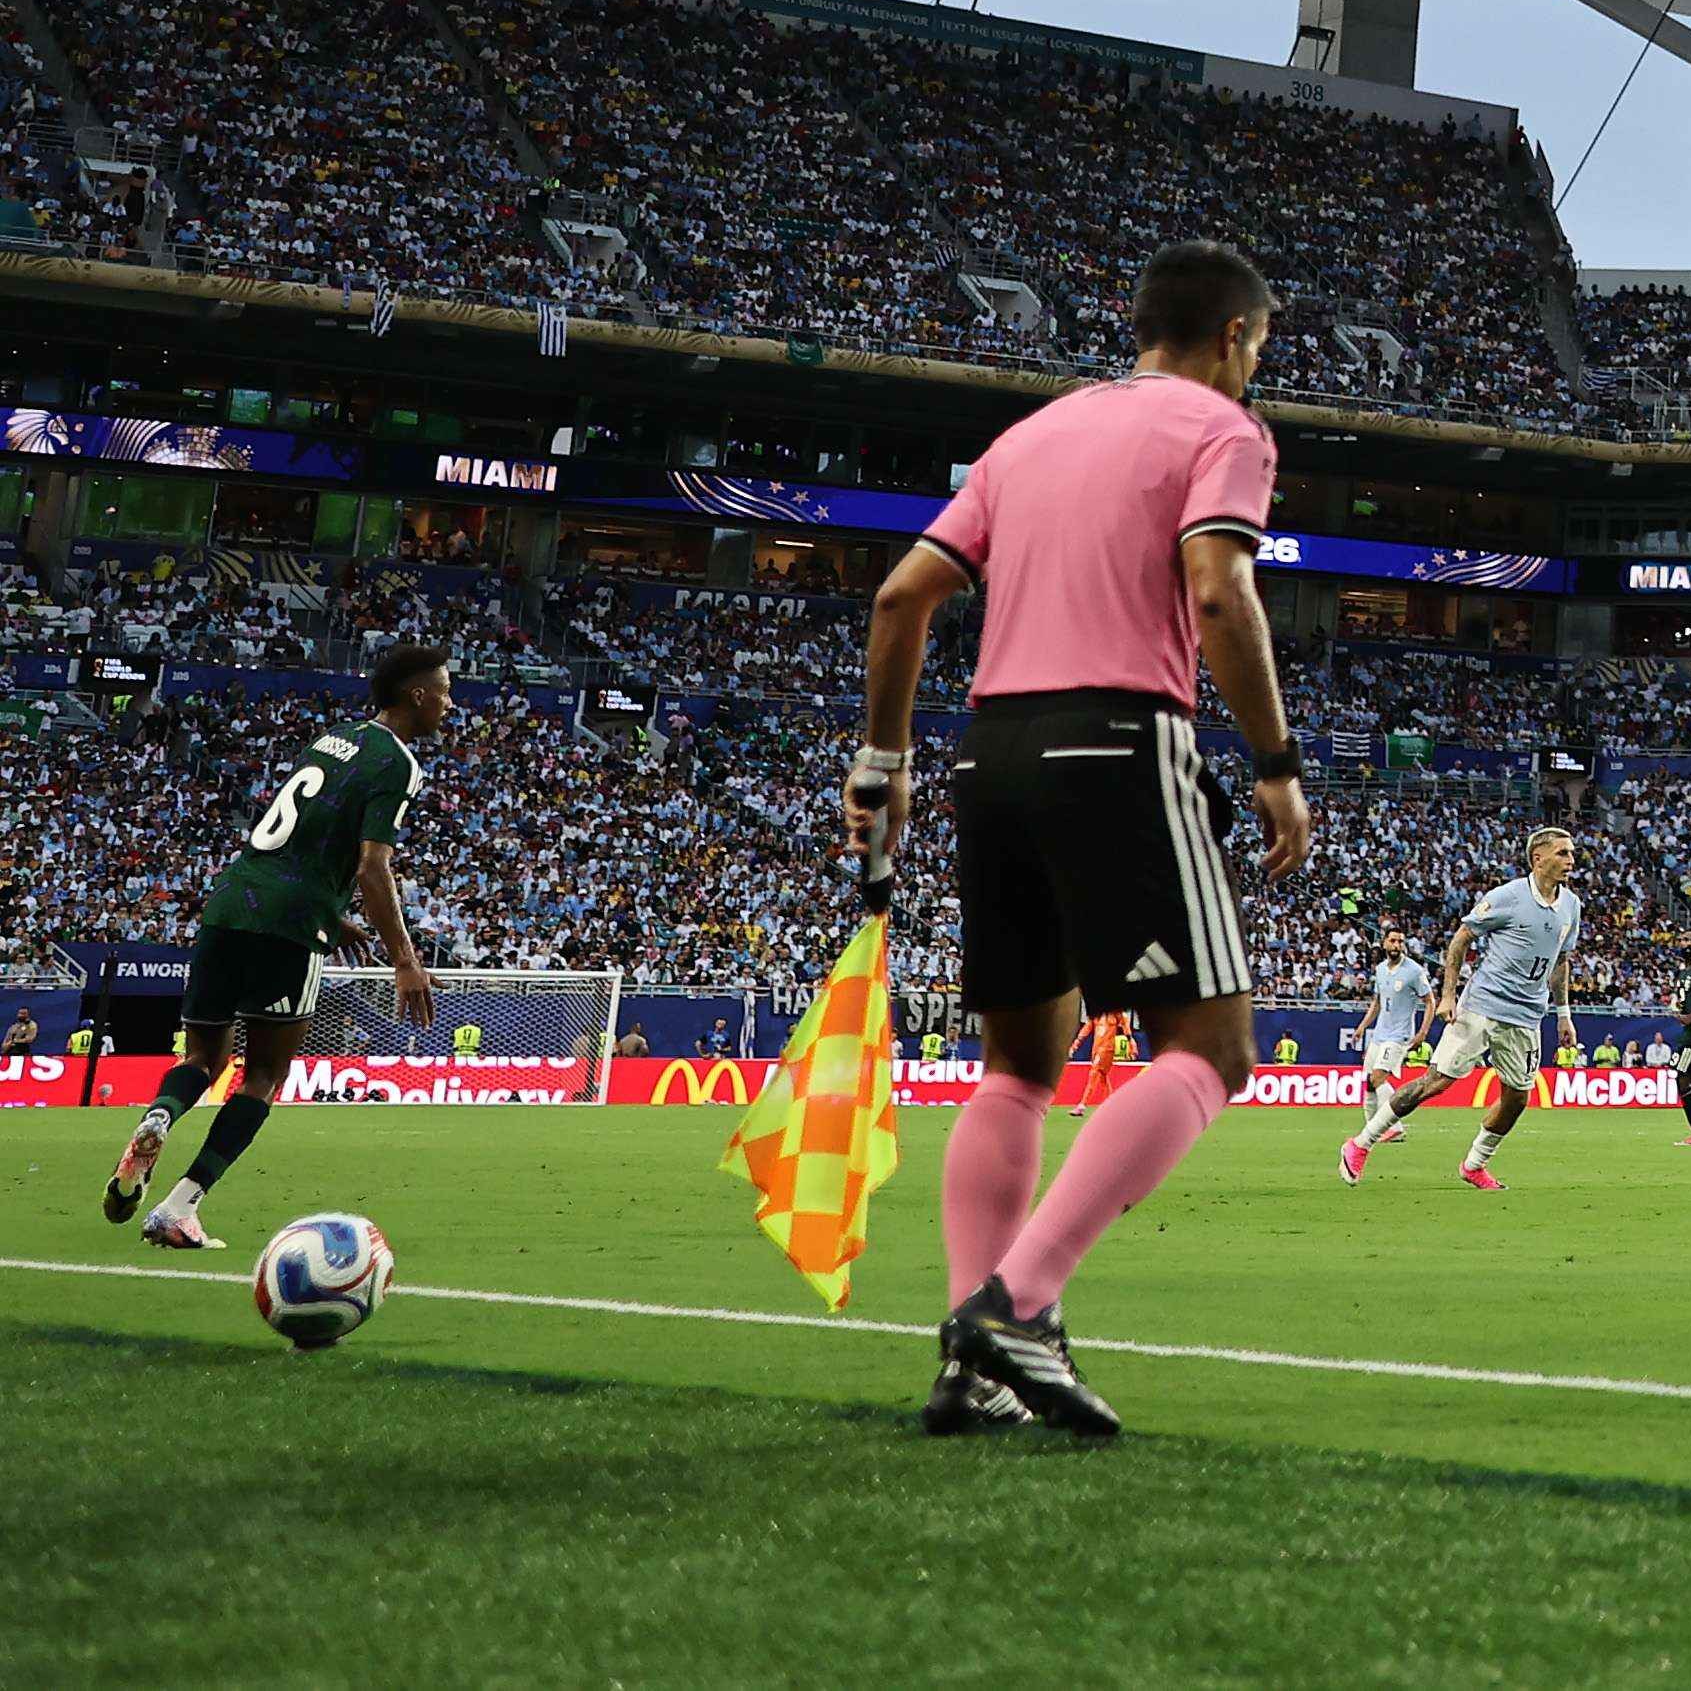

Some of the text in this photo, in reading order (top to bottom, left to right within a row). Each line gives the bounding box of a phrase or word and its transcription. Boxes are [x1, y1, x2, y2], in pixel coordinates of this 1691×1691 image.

[872, 7, 928, 28] BEHAVIOR
[1290, 80, 1325, 105] 308
[435, 455, 558, 492] MIAMI
[250, 766, 325, 851] 6
[1529, 955, 1549, 982] 13
[1525, 1049, 1540, 1074] 13
